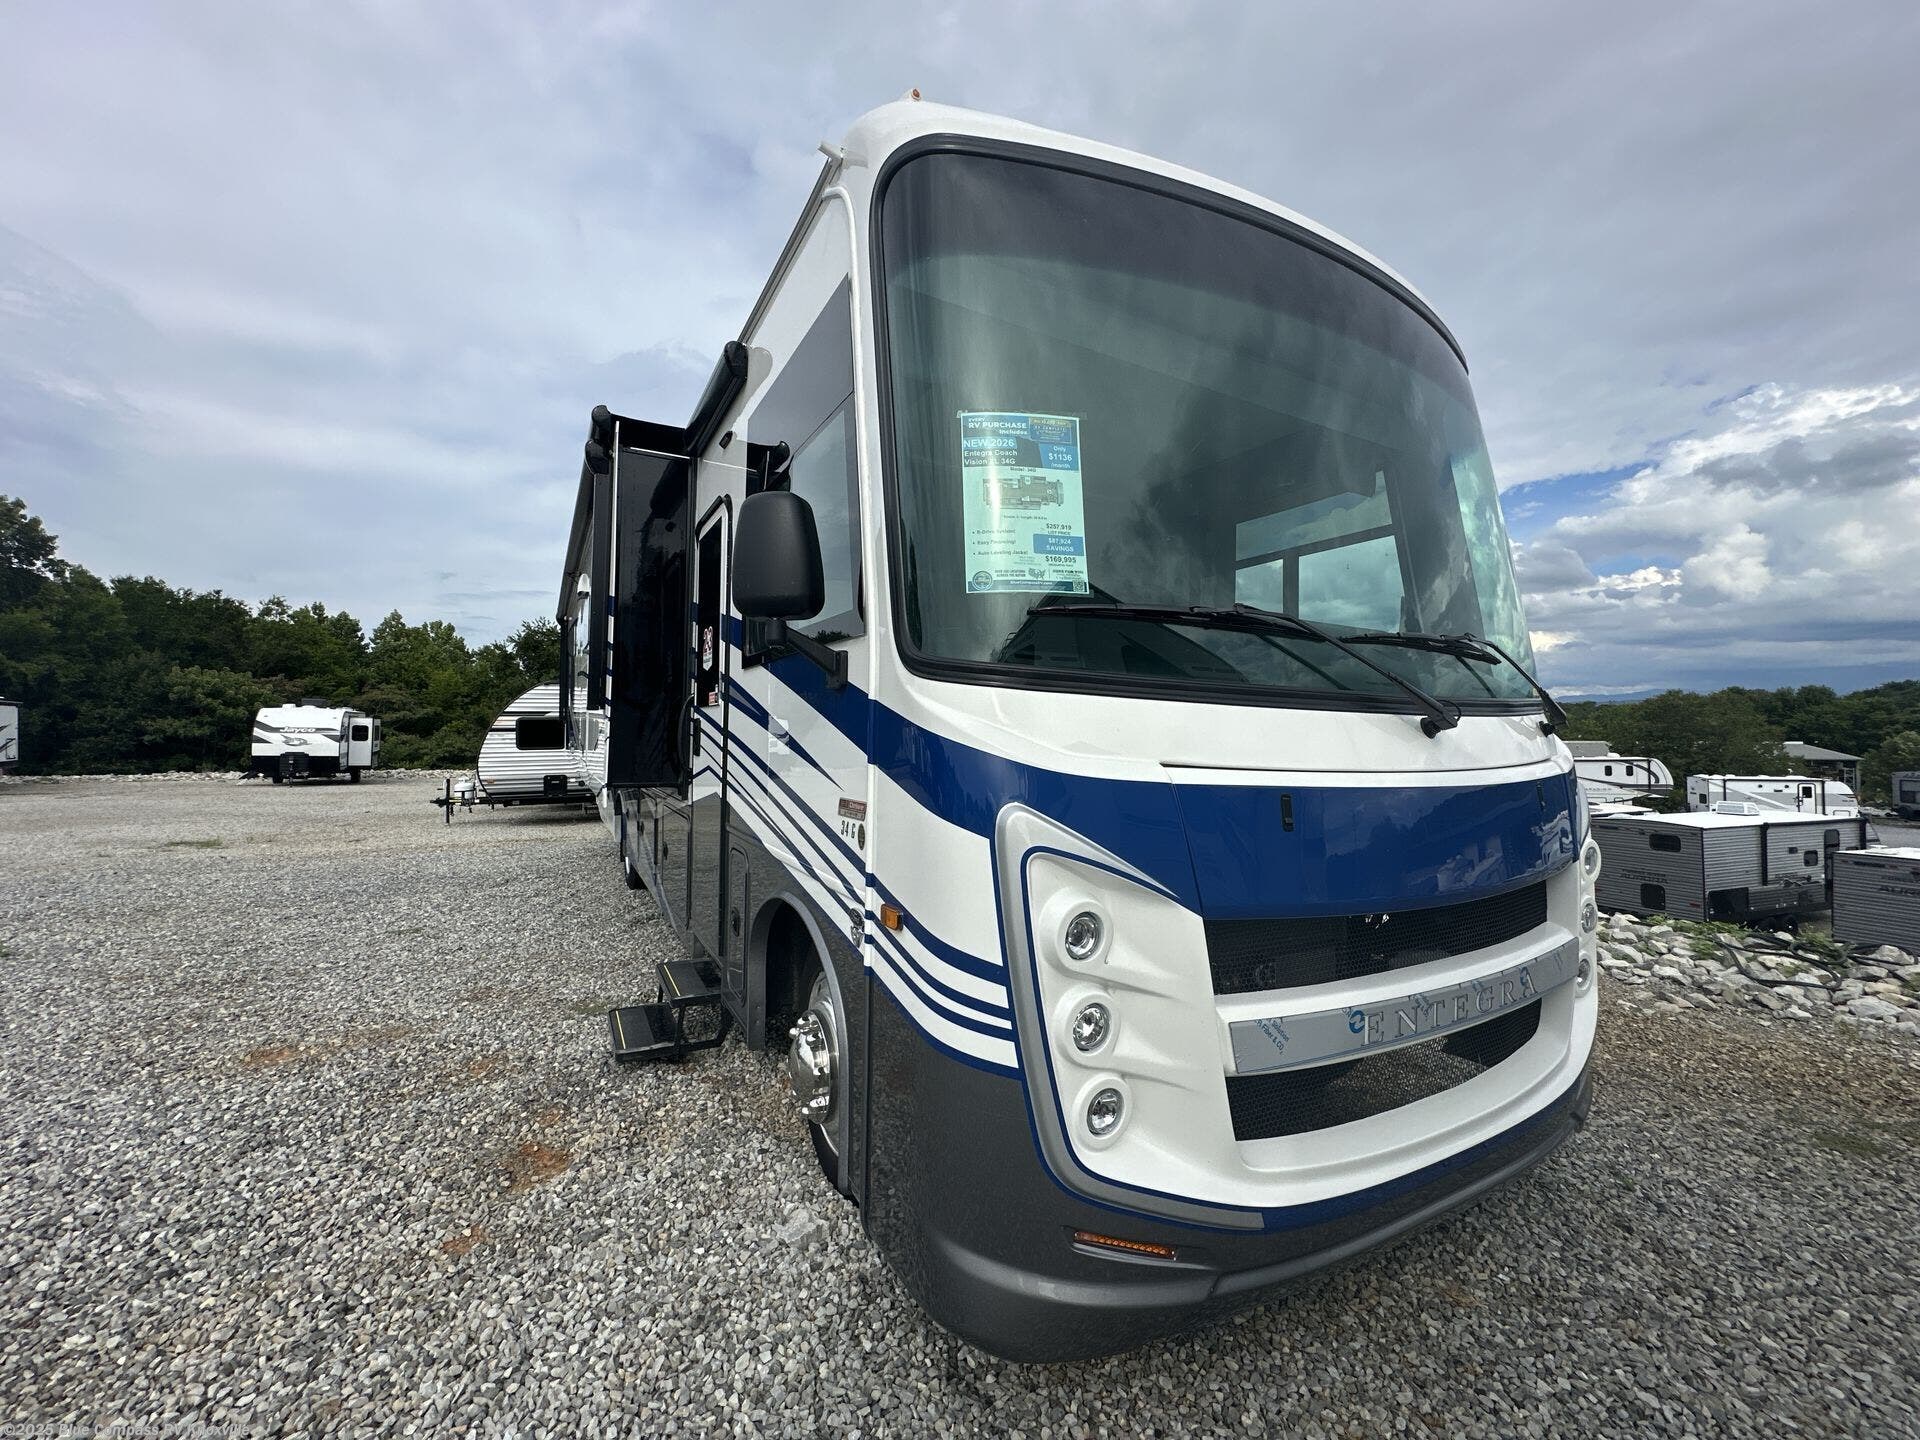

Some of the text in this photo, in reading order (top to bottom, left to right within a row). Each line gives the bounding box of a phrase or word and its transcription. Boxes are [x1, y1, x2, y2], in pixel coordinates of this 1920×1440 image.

[964, 438, 1015, 448] NEW 2026
[1048, 452, 1072, 462] $1136
[280, 726, 316, 734] Jayco
[841, 820, 856, 838] 34 G
[1361, 970, 1538, 1046] ENTEGRA
